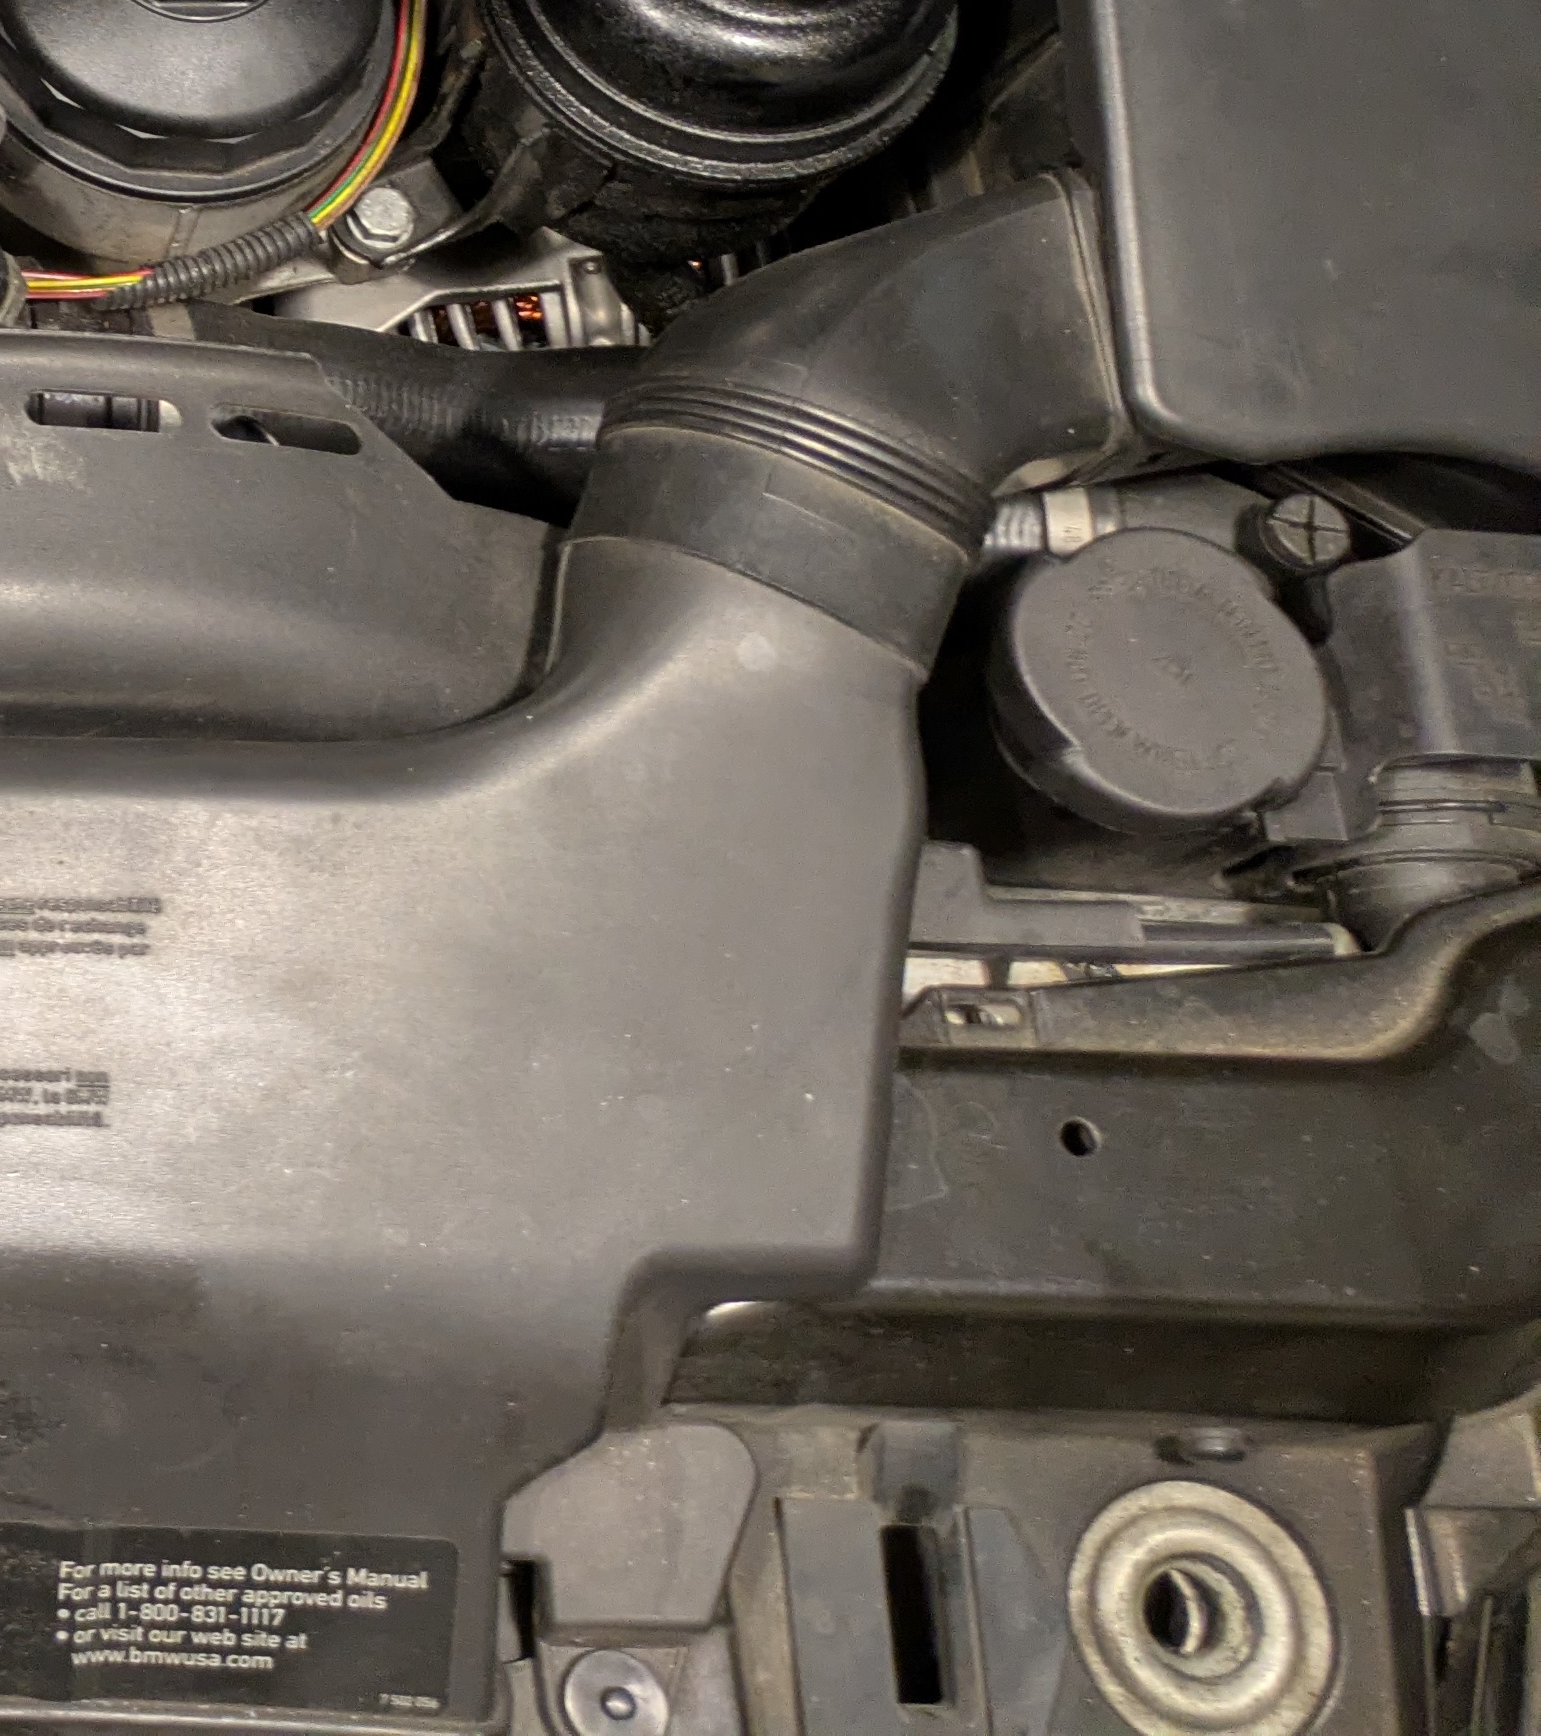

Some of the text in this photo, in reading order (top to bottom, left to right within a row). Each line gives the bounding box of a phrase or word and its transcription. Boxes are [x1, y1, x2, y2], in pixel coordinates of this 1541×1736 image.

[58, 1560, 429, 1588] For more info see Owner's Manual
[57, 1582, 387, 1610] For a list of other approved oils
[74, 1602, 286, 1627] call 1-800-831-1117
[73, 1624, 308, 1649] or visit our web site at
[71, 1647, 274, 1670] www.bmwusa.com
